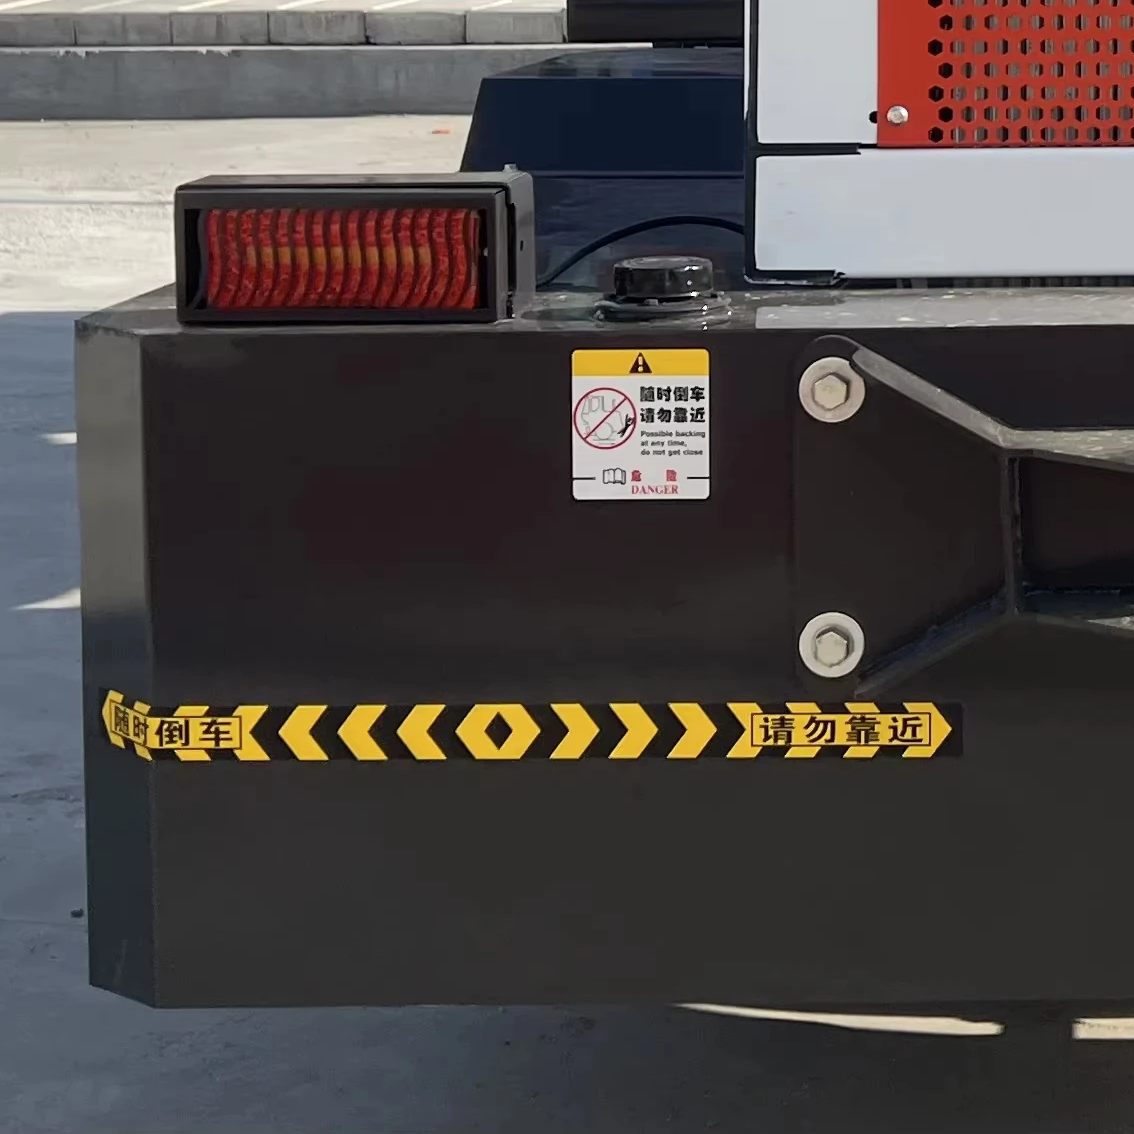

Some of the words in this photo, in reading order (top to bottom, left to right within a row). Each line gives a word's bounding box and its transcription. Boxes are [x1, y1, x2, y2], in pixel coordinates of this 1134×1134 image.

[640, 386, 705, 402] 随时倒车
[640, 407, 705, 423] 请勿靠近
[675, 430, 706, 438] backing
[631, 485, 679, 494] DANGER
[114, 706, 233, 747] 随时倒车
[759, 714, 923, 744] 请勿靠近
